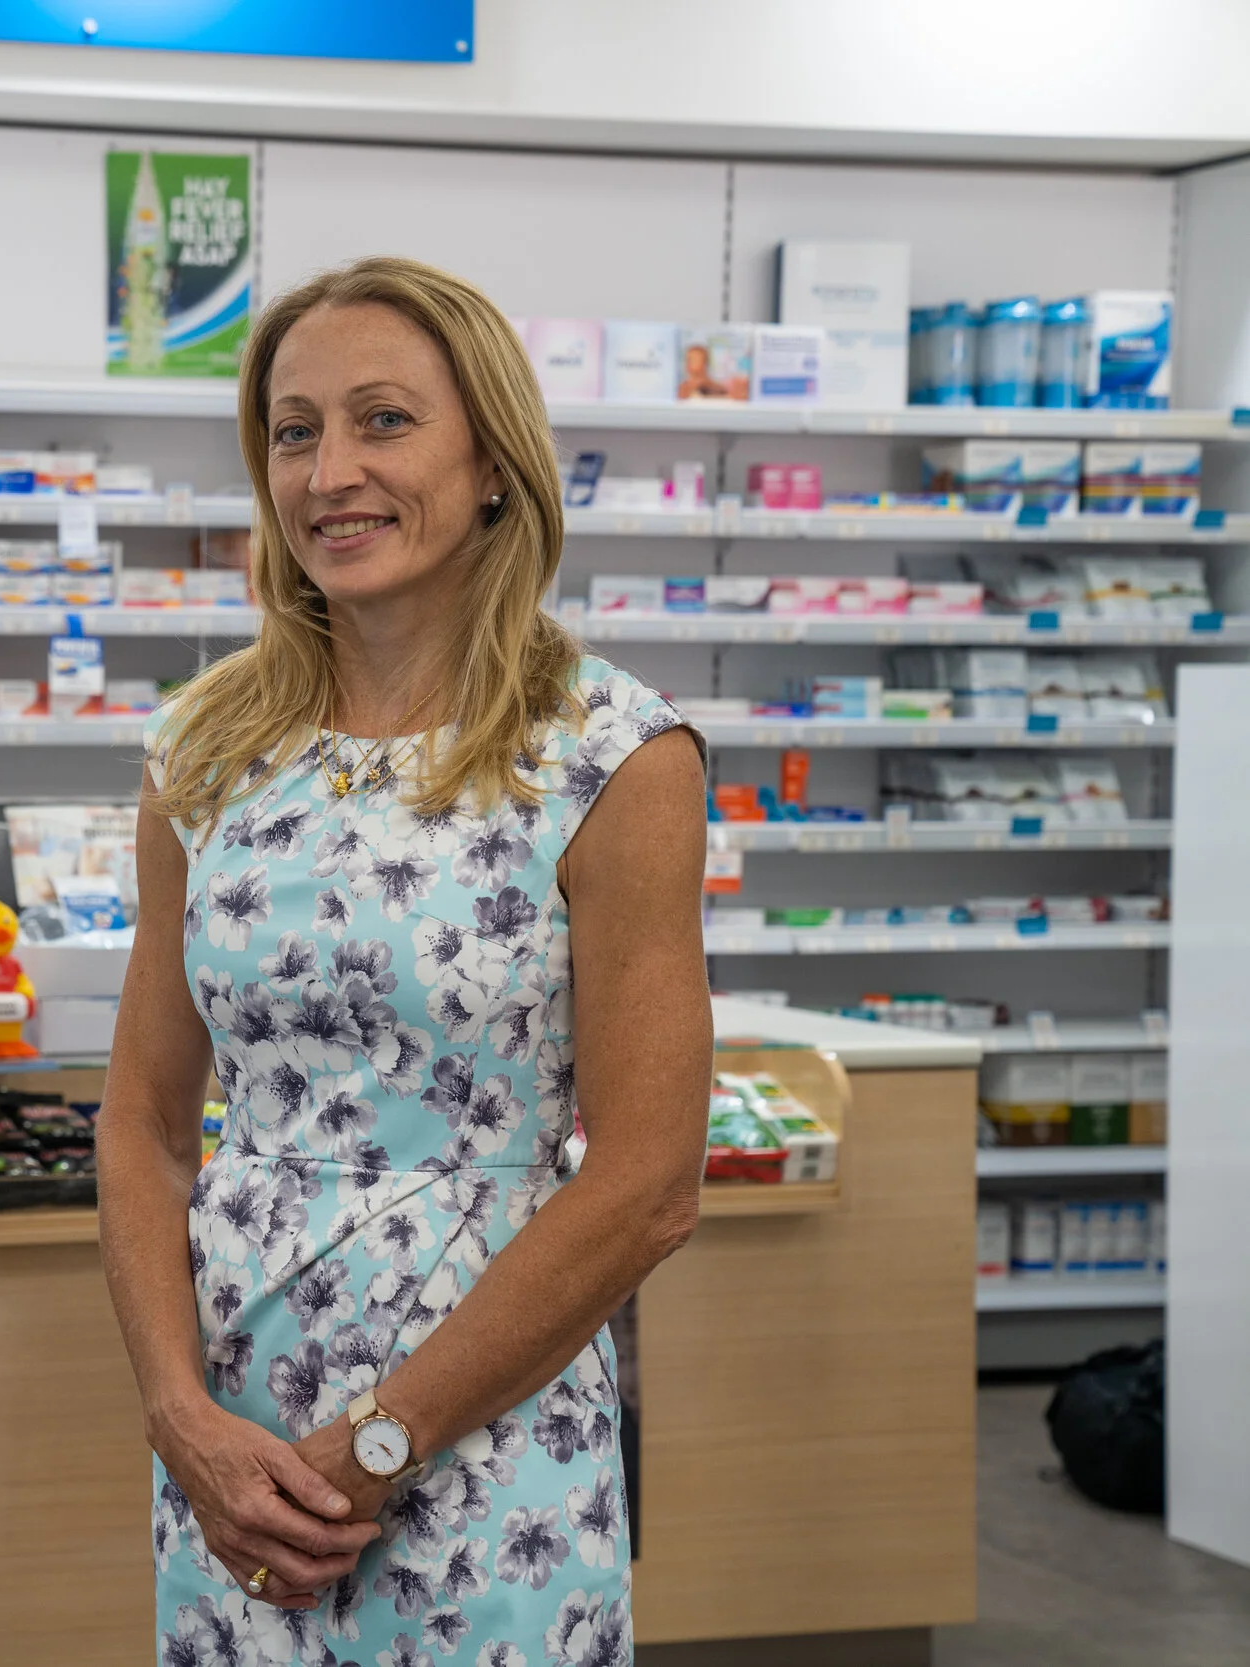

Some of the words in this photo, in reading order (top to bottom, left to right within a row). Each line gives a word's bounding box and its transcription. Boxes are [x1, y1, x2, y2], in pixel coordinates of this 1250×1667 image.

[183, 175, 230, 197] HAY
[170, 197, 243, 219] FEVER
[169, 219, 245, 242] RELIEF
[178, 243, 237, 266] ASAP
